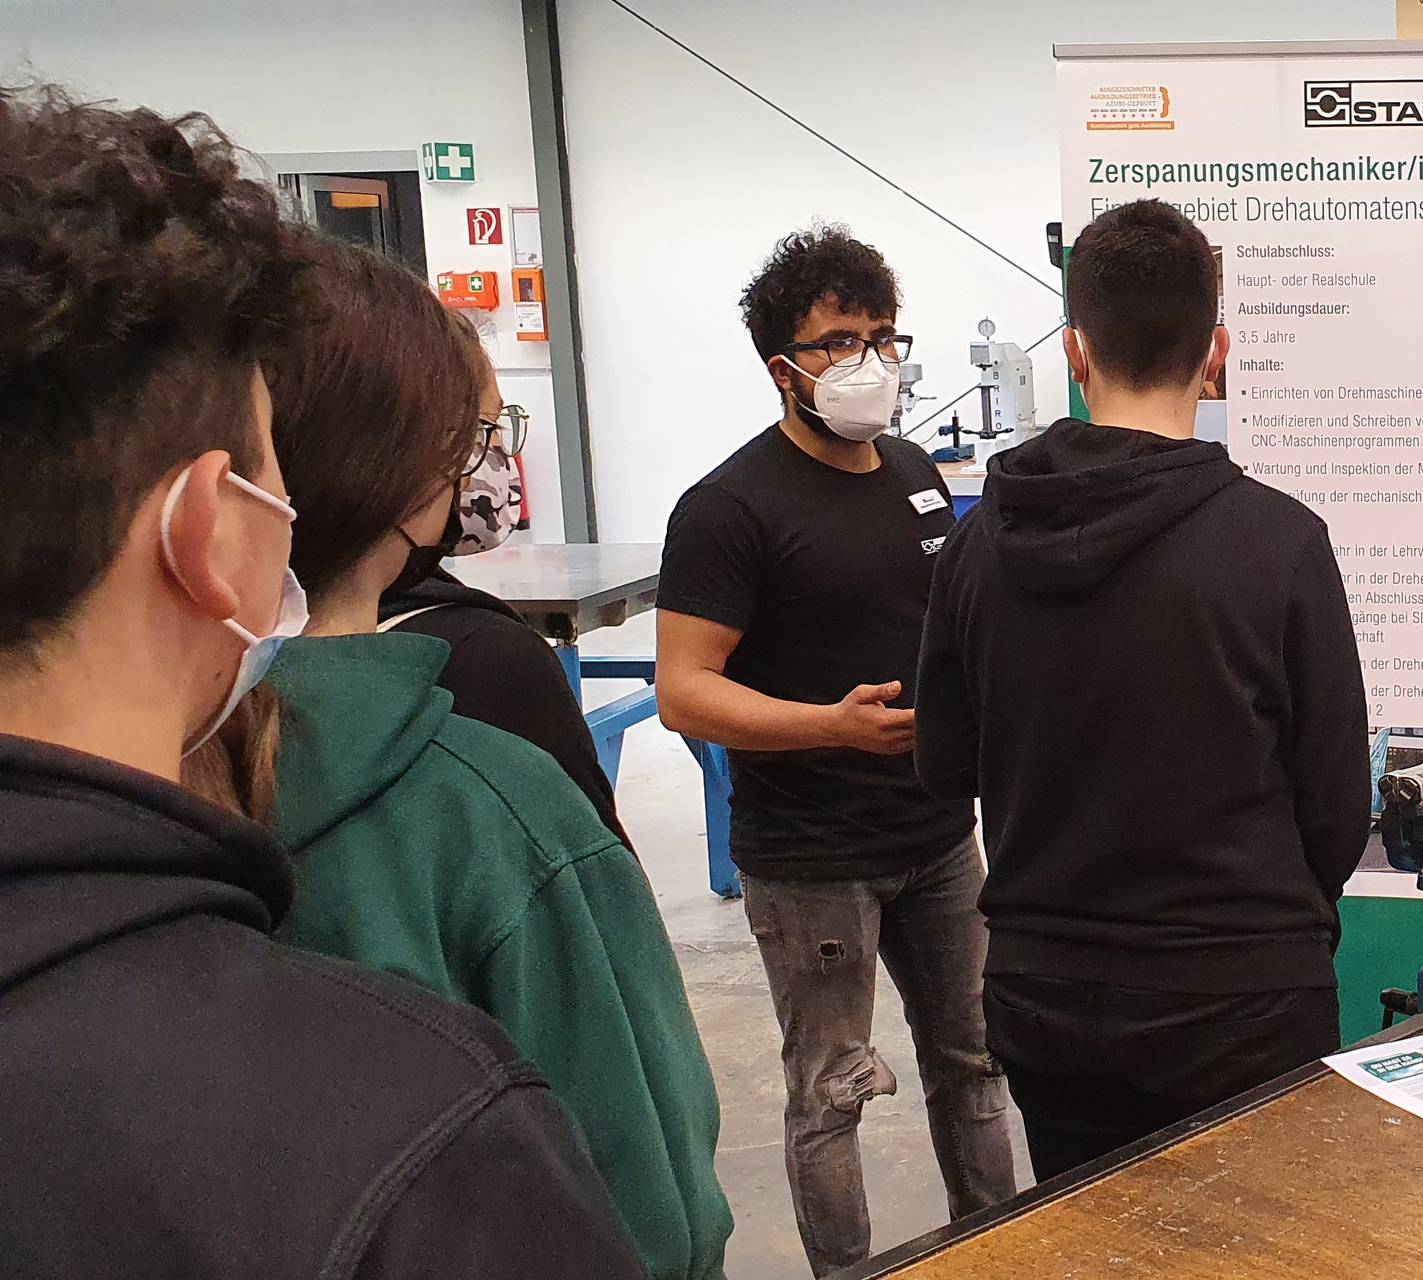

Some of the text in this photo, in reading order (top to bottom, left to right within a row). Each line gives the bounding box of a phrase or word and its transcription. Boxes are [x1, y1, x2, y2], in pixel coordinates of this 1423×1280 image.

[1091, 197, 1238, 222] Eiebiet
[1237, 245, 1334, 257] Schulabschluss:
[1238, 273, 1375, 288] Haupt- oder Realschule
[1238, 302, 1349, 317] Ausbildungsdauer:
[1239, 331, 1295, 344] 3,5 Jahre
[1240, 359, 1283, 371] Inhalte:
[1252, 387, 1309, 399] Einrichten
[1314, 390, 1333, 399] von
[1253, 414, 1322, 427] Modifizieren
[1328, 414, 1348, 427] und
[1353, 414, 1411, 427] Schreiben
[1252, 434, 1419, 449] CNC-Maschinenprogrammen
[1251, 462, 1300, 478] Wartung
[1306, 462, 1326, 475] und
[1332, 462, 1390, 477] Inspektion
[1395, 463, 1413, 474] der
[1330, 490, 1348, 502] der
[1333, 544, 1351, 557] ahr
[1355, 544, 1364, 556] in
[1370, 545, 1388, 557] der
[1356, 572, 1365, 584] in
[1370, 572, 1388, 584] der
[1392, 612, 1407, 623] bei
[1371, 658, 1389, 669] der
[1371, 685, 1390, 696] der
[1376, 704, 1383, 716] 2
